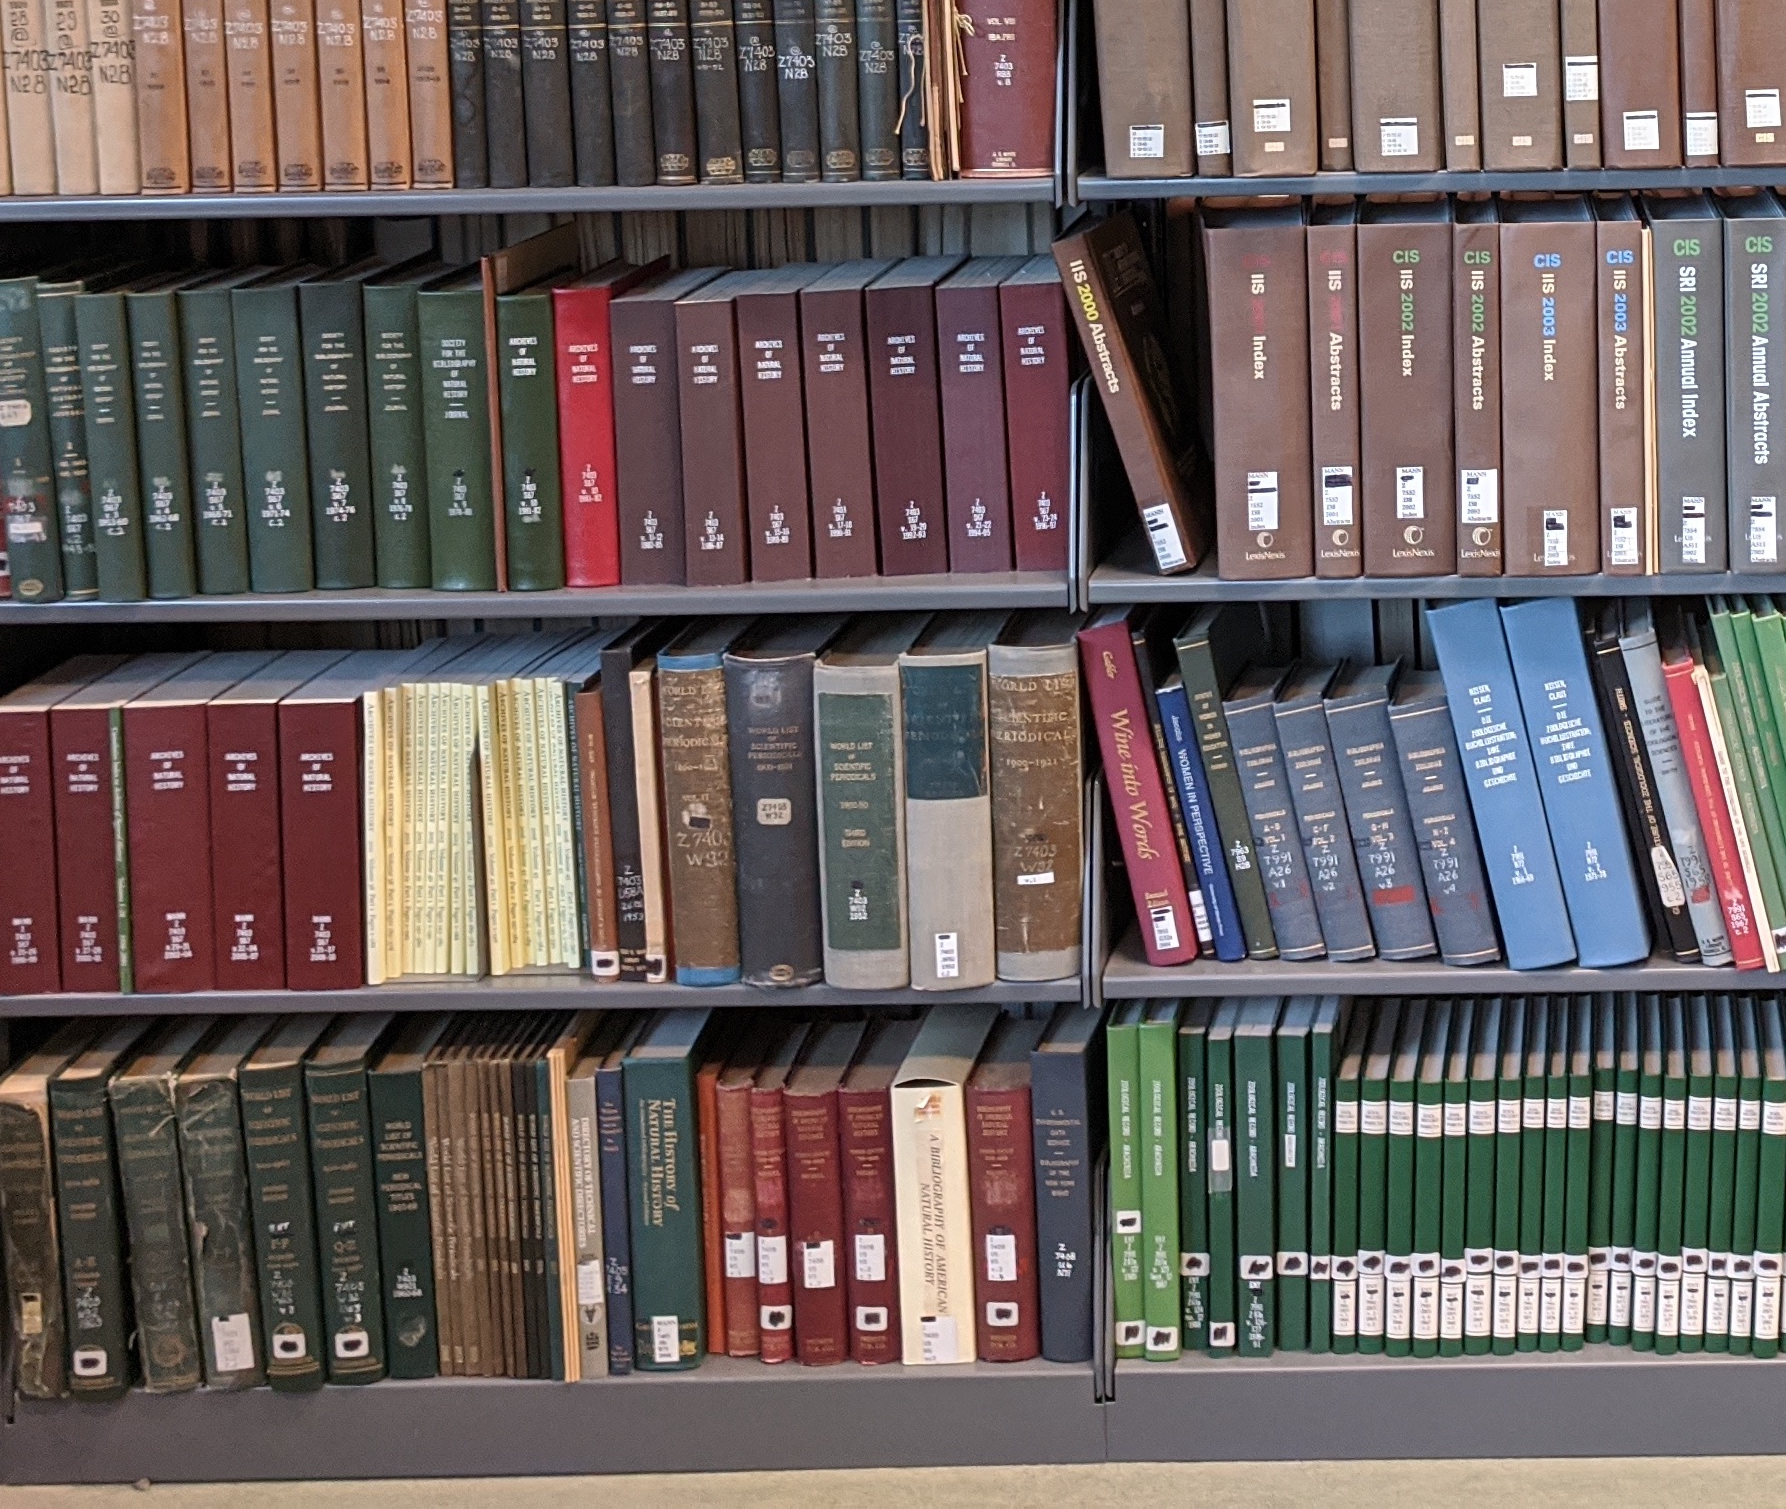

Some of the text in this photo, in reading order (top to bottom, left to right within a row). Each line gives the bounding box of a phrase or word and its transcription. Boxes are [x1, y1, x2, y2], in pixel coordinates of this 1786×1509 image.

[777, 56, 815, 68] Z7403
[784, 68, 809, 80] N28
[822, 45, 848, 57] N28
[1391, 248, 1421, 265] CIS
[1462, 249, 1492, 266] CIS
[1532, 252, 1562, 269] CIS
[1605, 248, 1634, 265] CIS
[1672, 239, 1701, 256] CIS
[1744, 236, 1773, 254] CIS
[1068, 259, 1121, 395] IIS 2000 Abstracts
[1398, 267, 1416, 378] IIS 2002 Index
[1470, 269, 1486, 411] IIS 2002 Abstracts
[1540, 272, 1557, 382] IIS 2003 Index
[1612, 269, 1629, 411] IIS 2003 Abstracts
[1678, 266, 1698, 440] SRI 2002 Annual Index
[1750, 262, 1770, 466] SRI 2002 Annual Abstracts
[1110, 708, 1160, 860] Wine into Words
[1178, 748, 1214, 876] WOMEN IN PERSPECTIVE
[1268, 866, 1292, 877] A26
[1318, 867, 1338, 880] A26
[649, 1100, 664, 1226] NATURAL HISTORY
[663, 1100, 680, 1212] THE HISTORY of
[922, 1183, 934, 1284] NATURAL HISTORY
[930, 1135, 948, 1313] A BIBLIOGRAPHY OF AMERICAN
